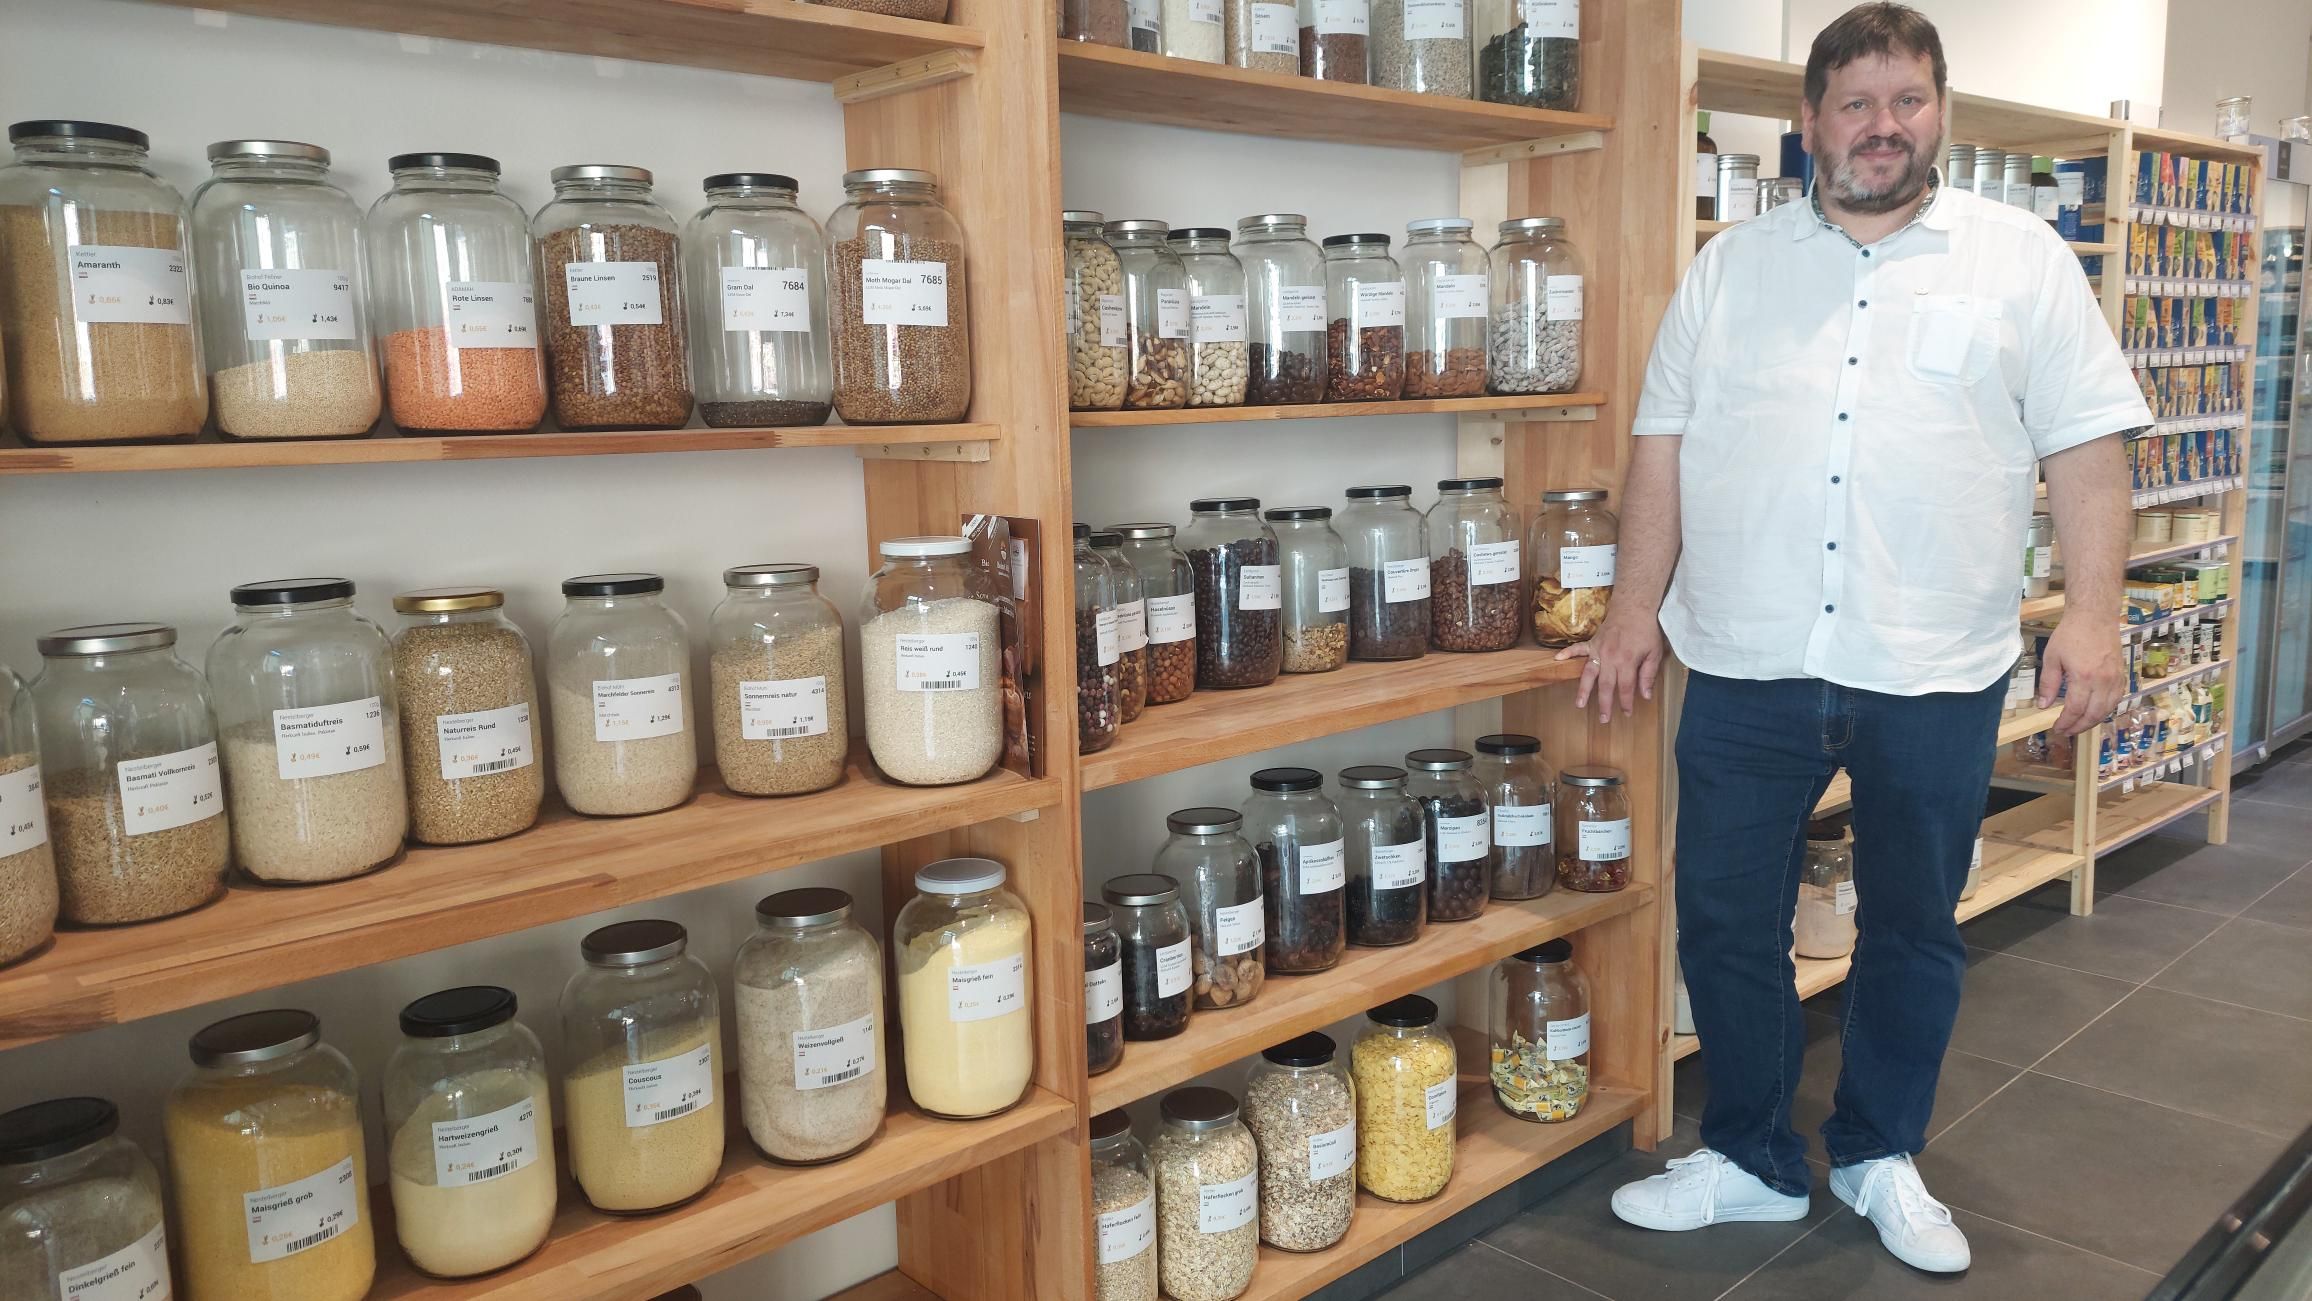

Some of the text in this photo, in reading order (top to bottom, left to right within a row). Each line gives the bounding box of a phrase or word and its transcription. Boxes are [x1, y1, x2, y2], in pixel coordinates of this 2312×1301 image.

[77, 260, 121, 269] Amaranth
[782, 280, 805, 291] 7684
[882, 278, 900, 286] Mogar
[921, 274, 943, 286] 7685
[247, 283, 290, 291] Bio Quinoa
[333, 284, 349, 292] 9417
[280, 717, 344, 731] Basmatiduftreis
[443, 722, 496, 735] Naturreis Rund
[126, 772, 157, 783] Basmati
[952, 975, 982, 984] Maisgrieß
[628, 1074, 662, 1084] Couscous
[438, 1124, 499, 1142] Hartweizengrieß
[251, 1191, 314, 1214] Maisgrieß grob
[68, 1259, 136, 1294] Dinkelgrieß fein
